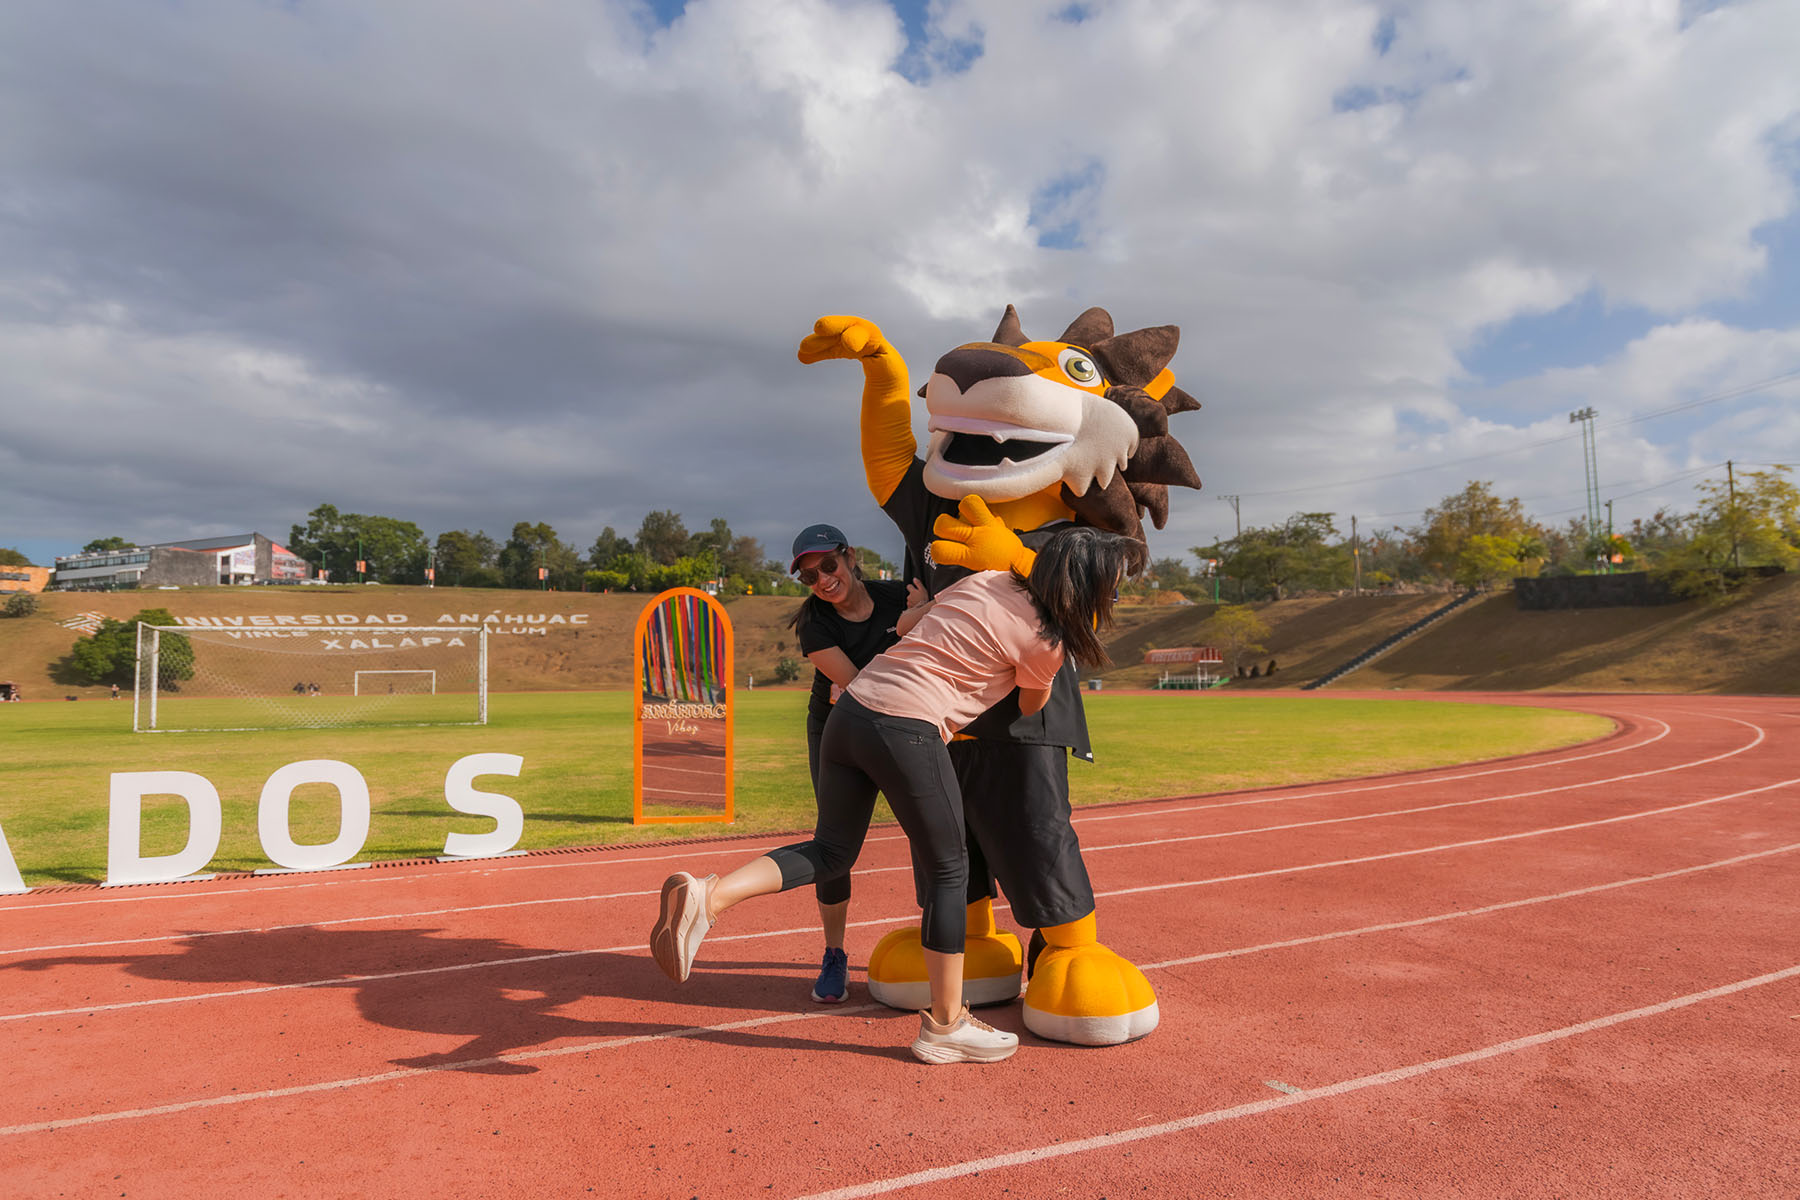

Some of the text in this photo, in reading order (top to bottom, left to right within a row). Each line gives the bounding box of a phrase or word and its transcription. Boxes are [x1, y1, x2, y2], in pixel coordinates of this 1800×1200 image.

[437, 609, 589, 625] ANÁHUAC
[320, 637, 466, 651] XALAPA
[0, 752, 524, 892] DOS
